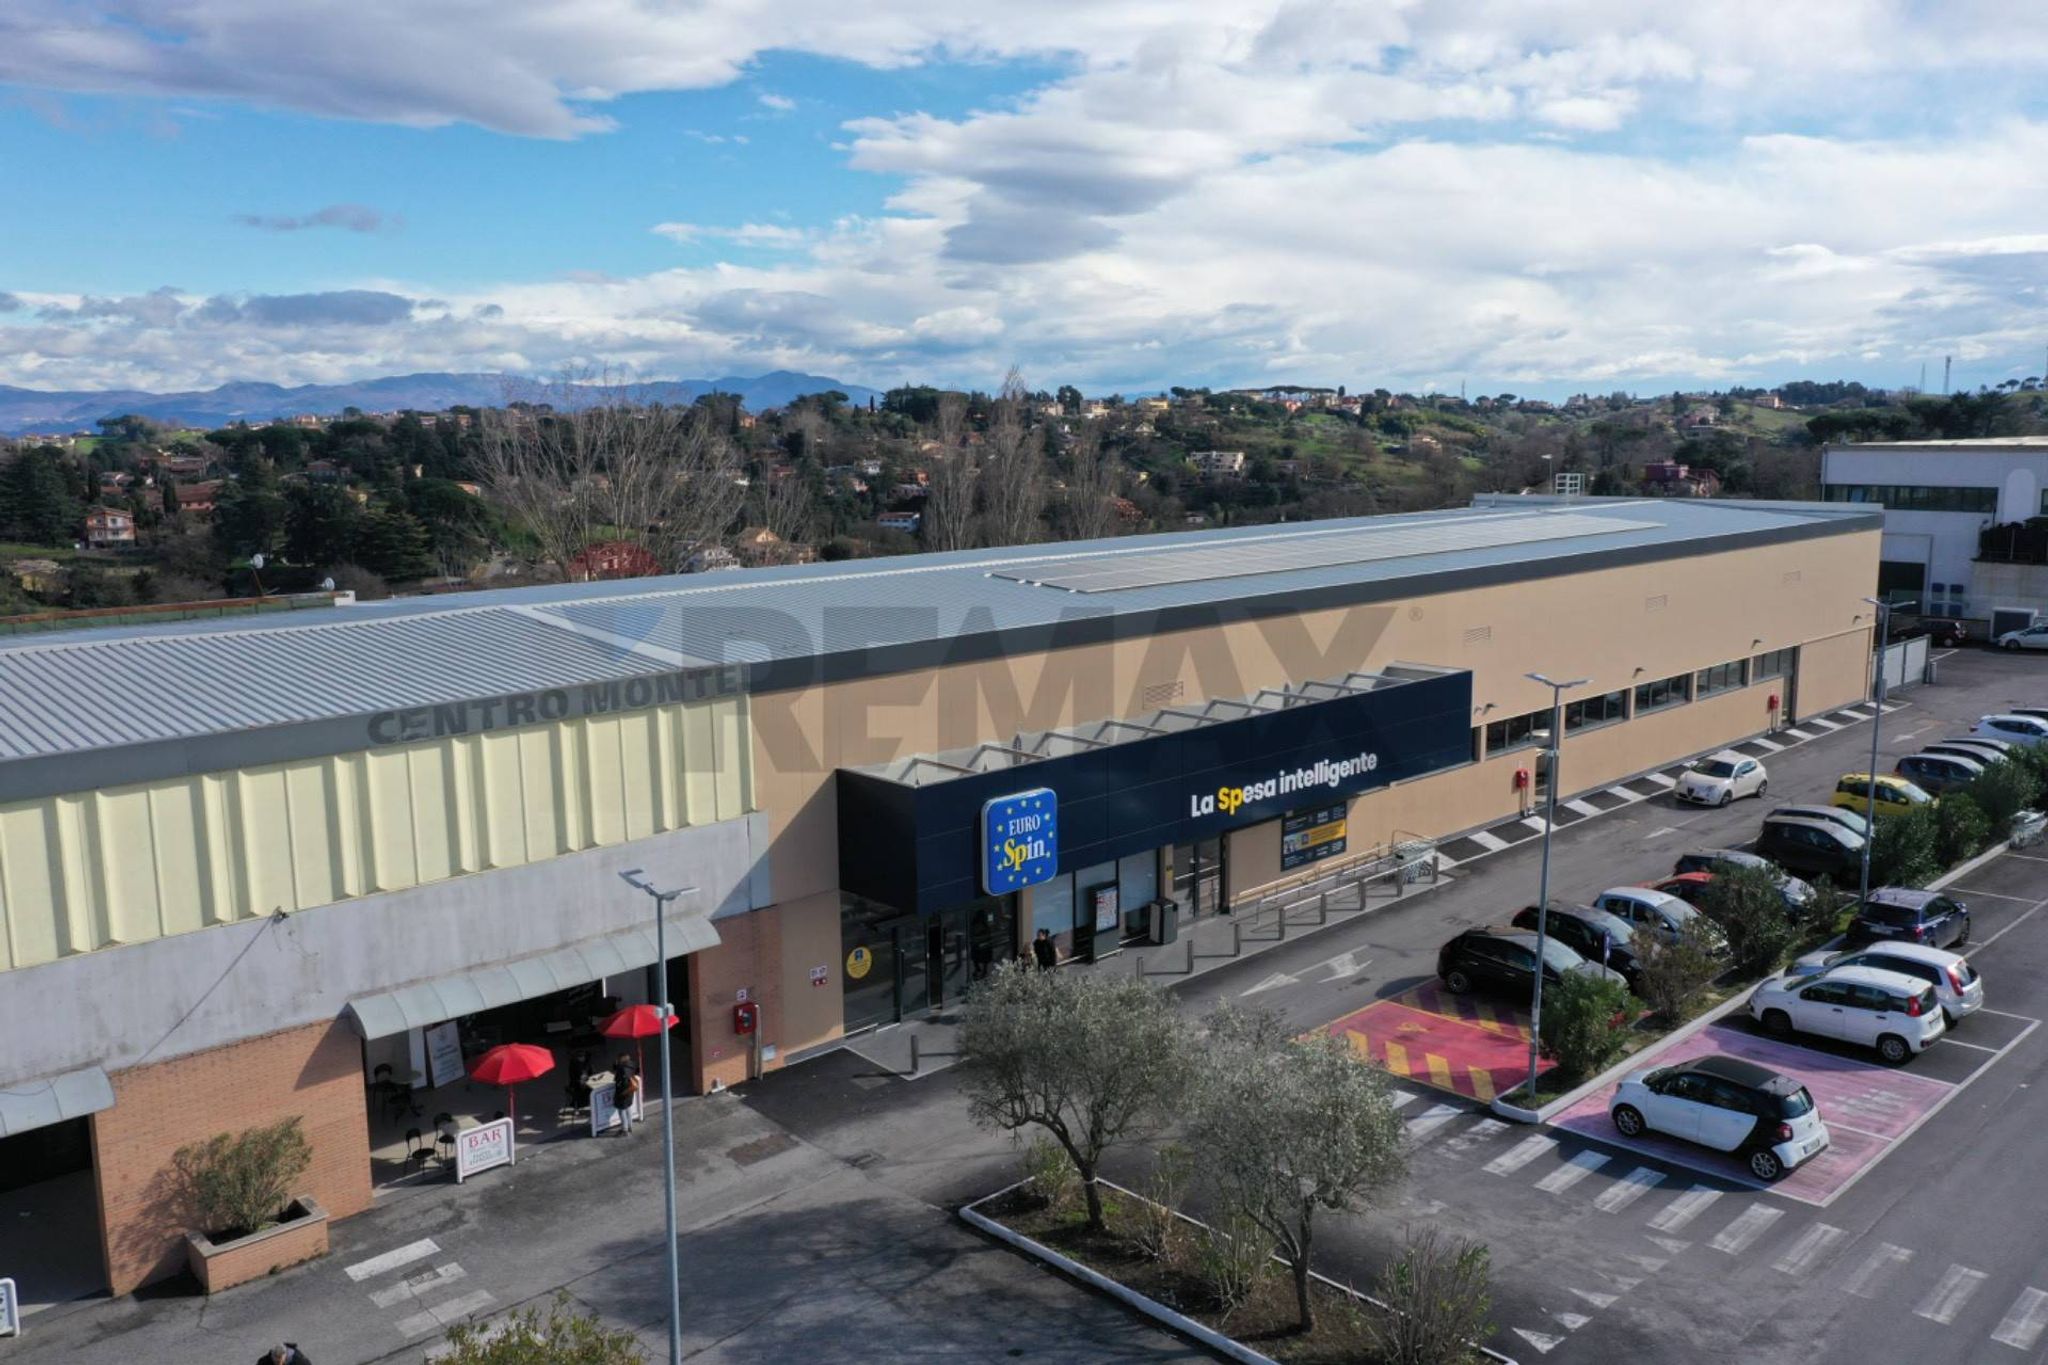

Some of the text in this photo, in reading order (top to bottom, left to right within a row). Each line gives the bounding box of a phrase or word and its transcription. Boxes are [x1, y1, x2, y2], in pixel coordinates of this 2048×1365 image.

[367, 665, 738, 745] CENTRO MONTE
[1191, 794, 1214, 817] La
[1279, 752, 1378, 794] intelligente
[1009, 814, 1041, 836] EURO
[1003, 836, 1046, 871] Spin
[469, 1129, 501, 1148] BAR
